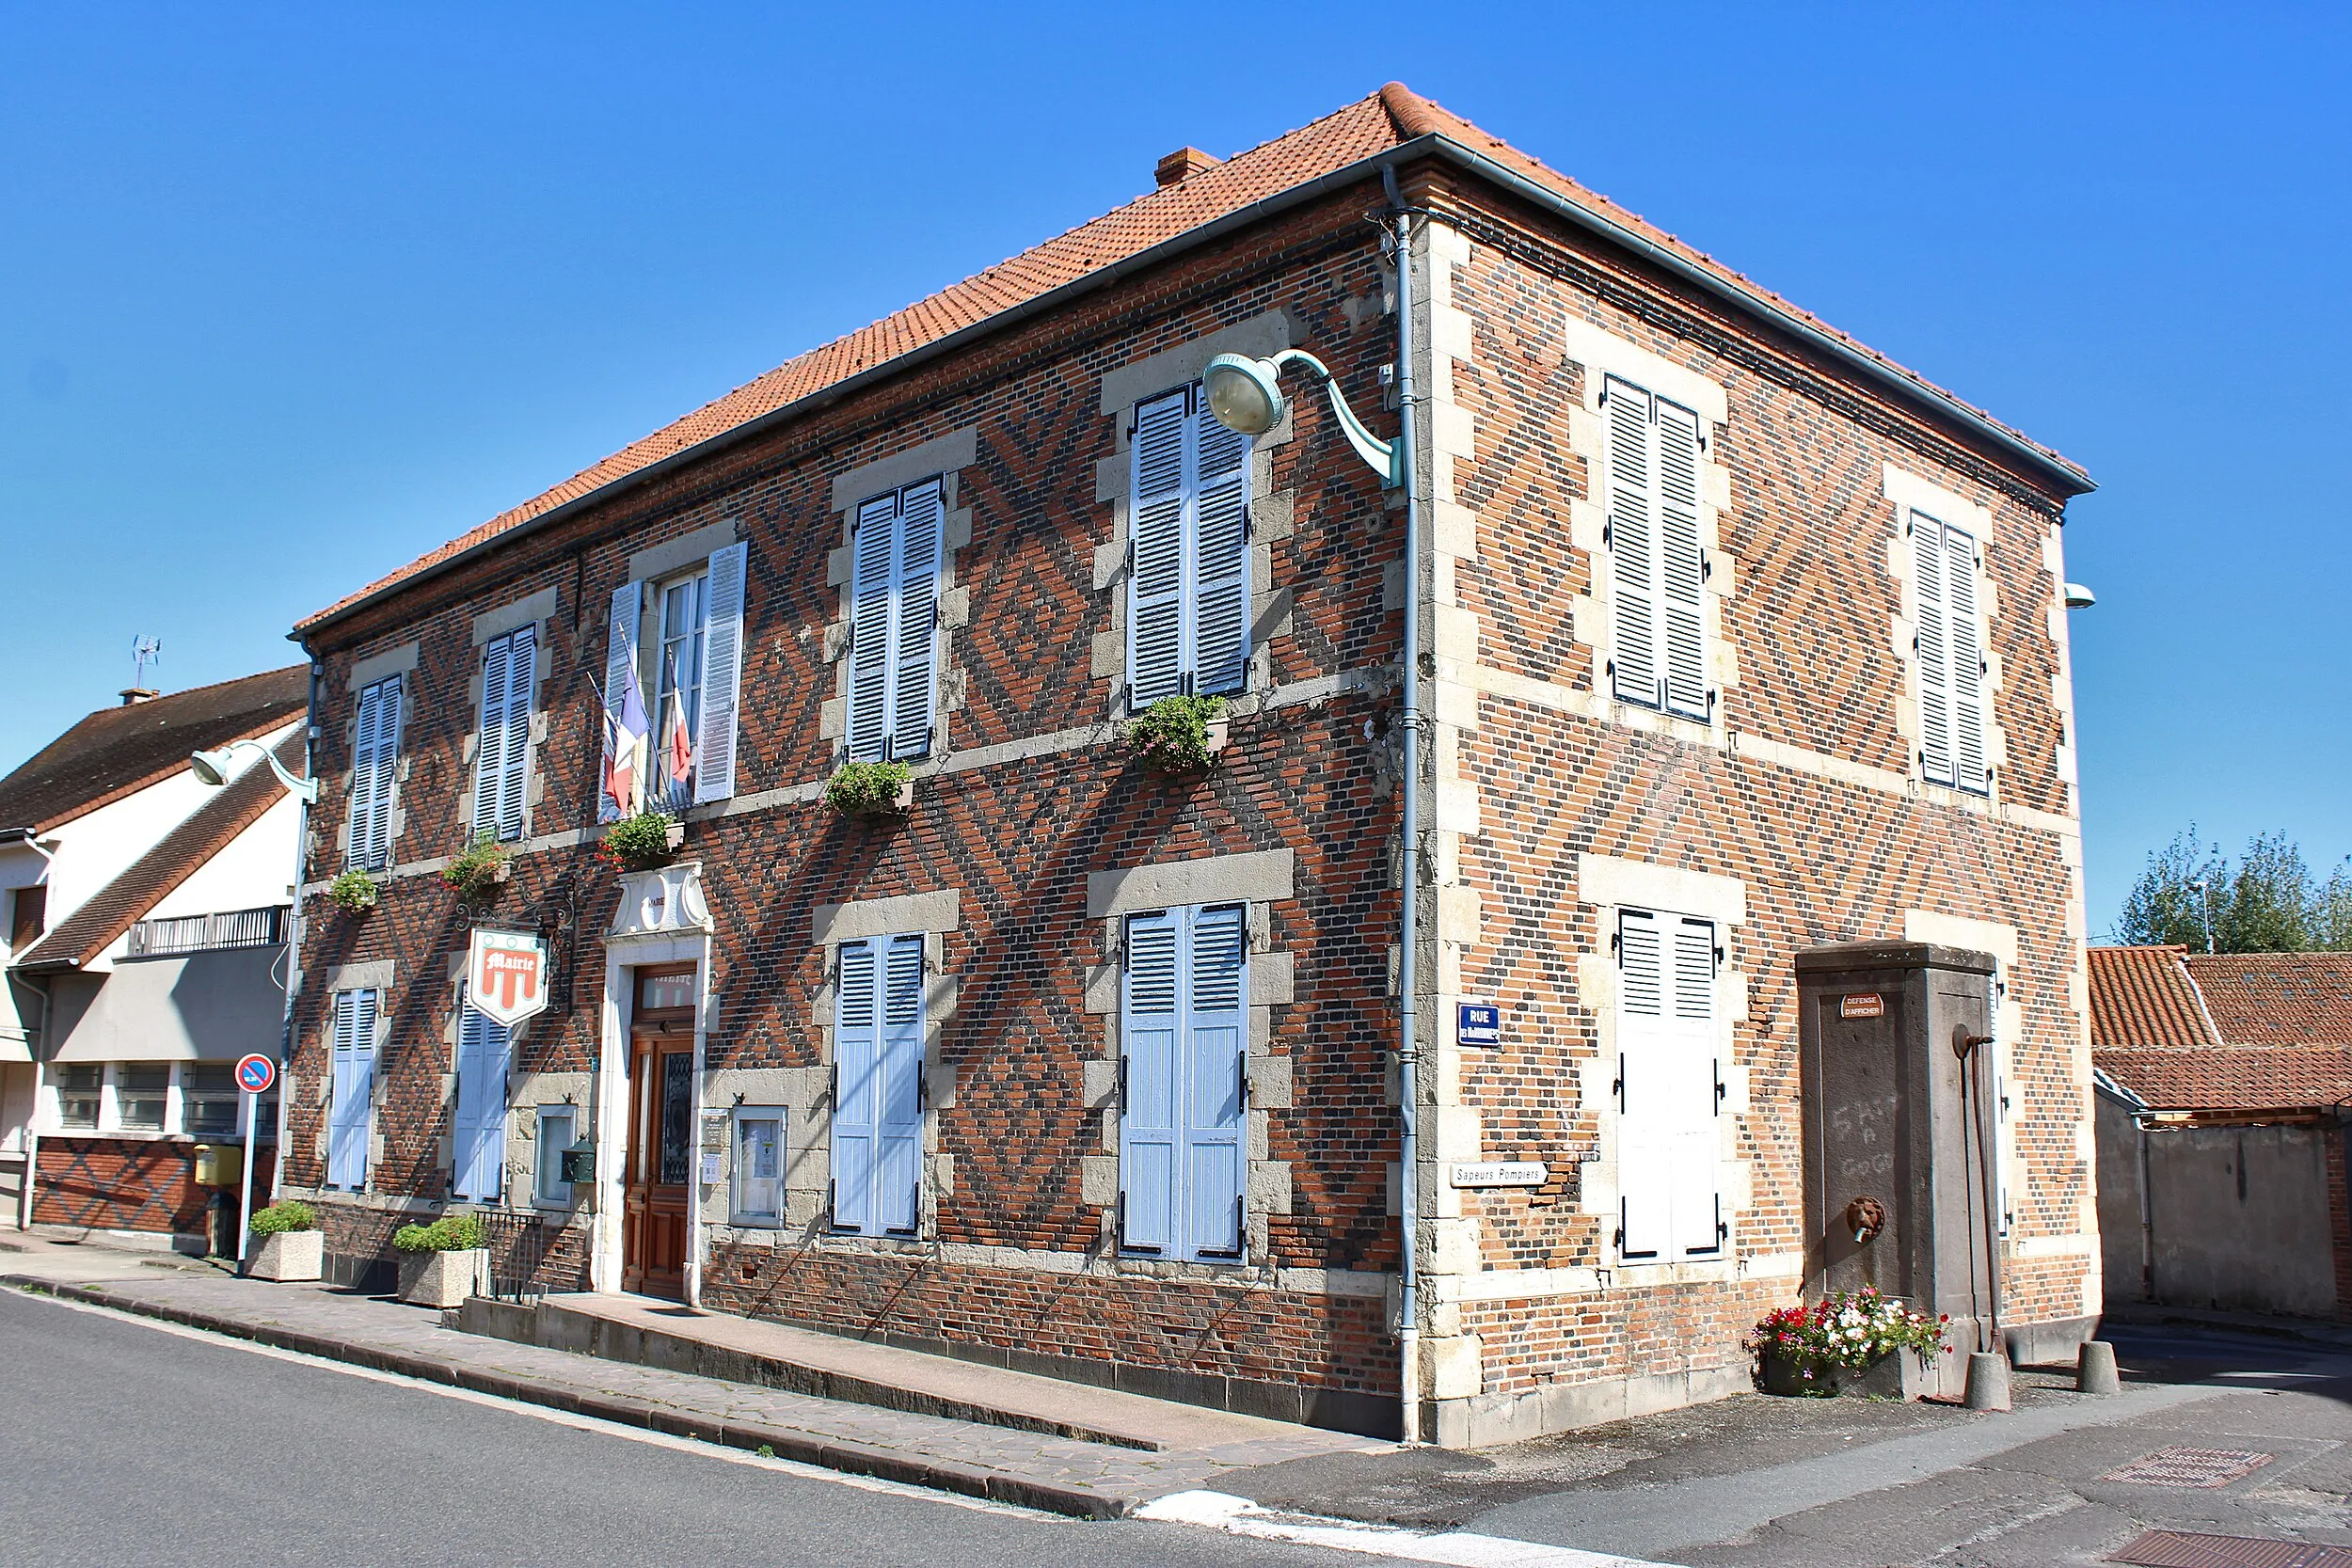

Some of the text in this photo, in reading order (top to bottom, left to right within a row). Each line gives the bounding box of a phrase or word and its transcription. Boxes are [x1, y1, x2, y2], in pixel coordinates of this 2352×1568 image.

[486, 952, 535, 972] Mairie
[1470, 1009, 1489, 1023] RUE
[1456, 1167, 1539, 1183] Sapeurs Pompiers
